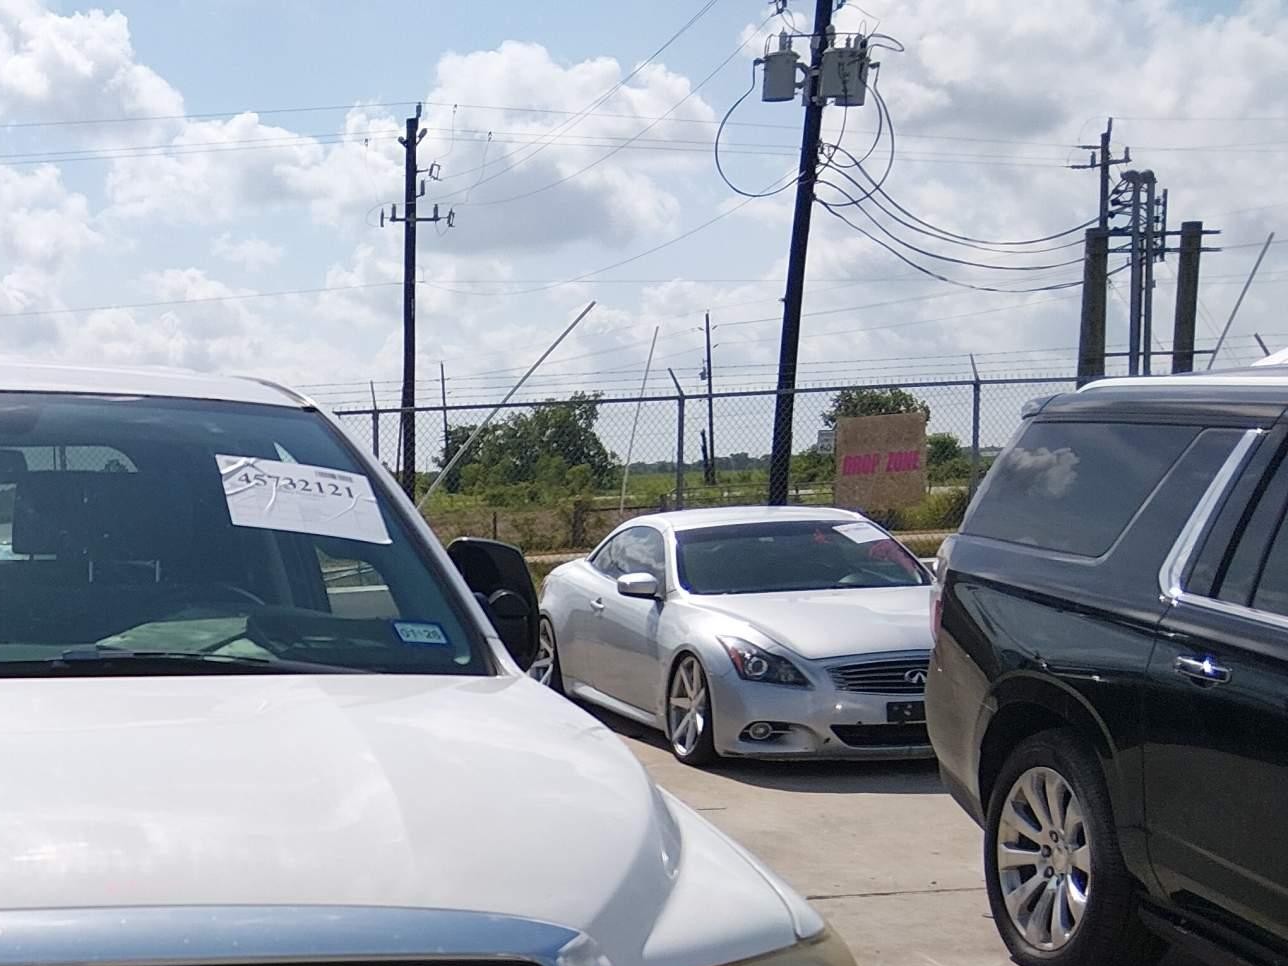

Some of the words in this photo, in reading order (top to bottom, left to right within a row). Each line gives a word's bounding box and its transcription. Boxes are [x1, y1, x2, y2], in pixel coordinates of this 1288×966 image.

[843, 455, 880, 476] DROP
[885, 451, 920, 473] ZONE
[237, 472, 354, 499] 45732121
